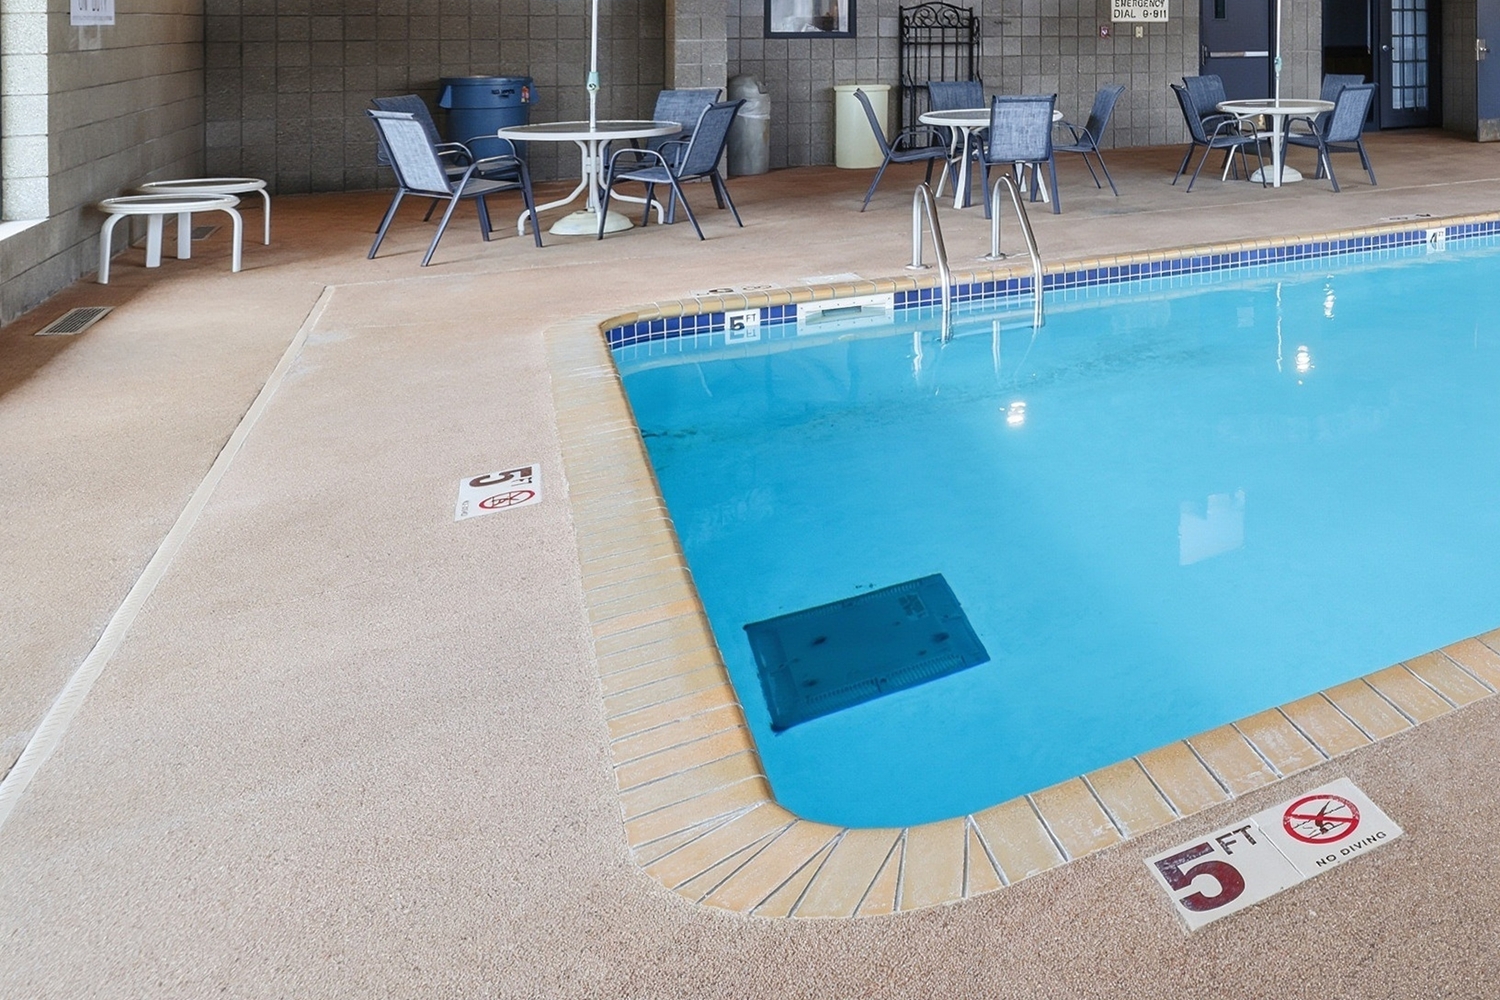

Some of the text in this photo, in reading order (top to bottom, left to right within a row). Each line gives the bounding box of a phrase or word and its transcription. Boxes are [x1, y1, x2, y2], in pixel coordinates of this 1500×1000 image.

[1113, 9, 1136, 18] DIAL
[1114, 0, 1166, 8] EMERGENCY
[729, 313, 756, 331] 5 FT
[469, 466, 532, 488] 5
[1315, 830, 1388, 868] NO DIVING
[1153, 824, 1257, 912] 5 FT
